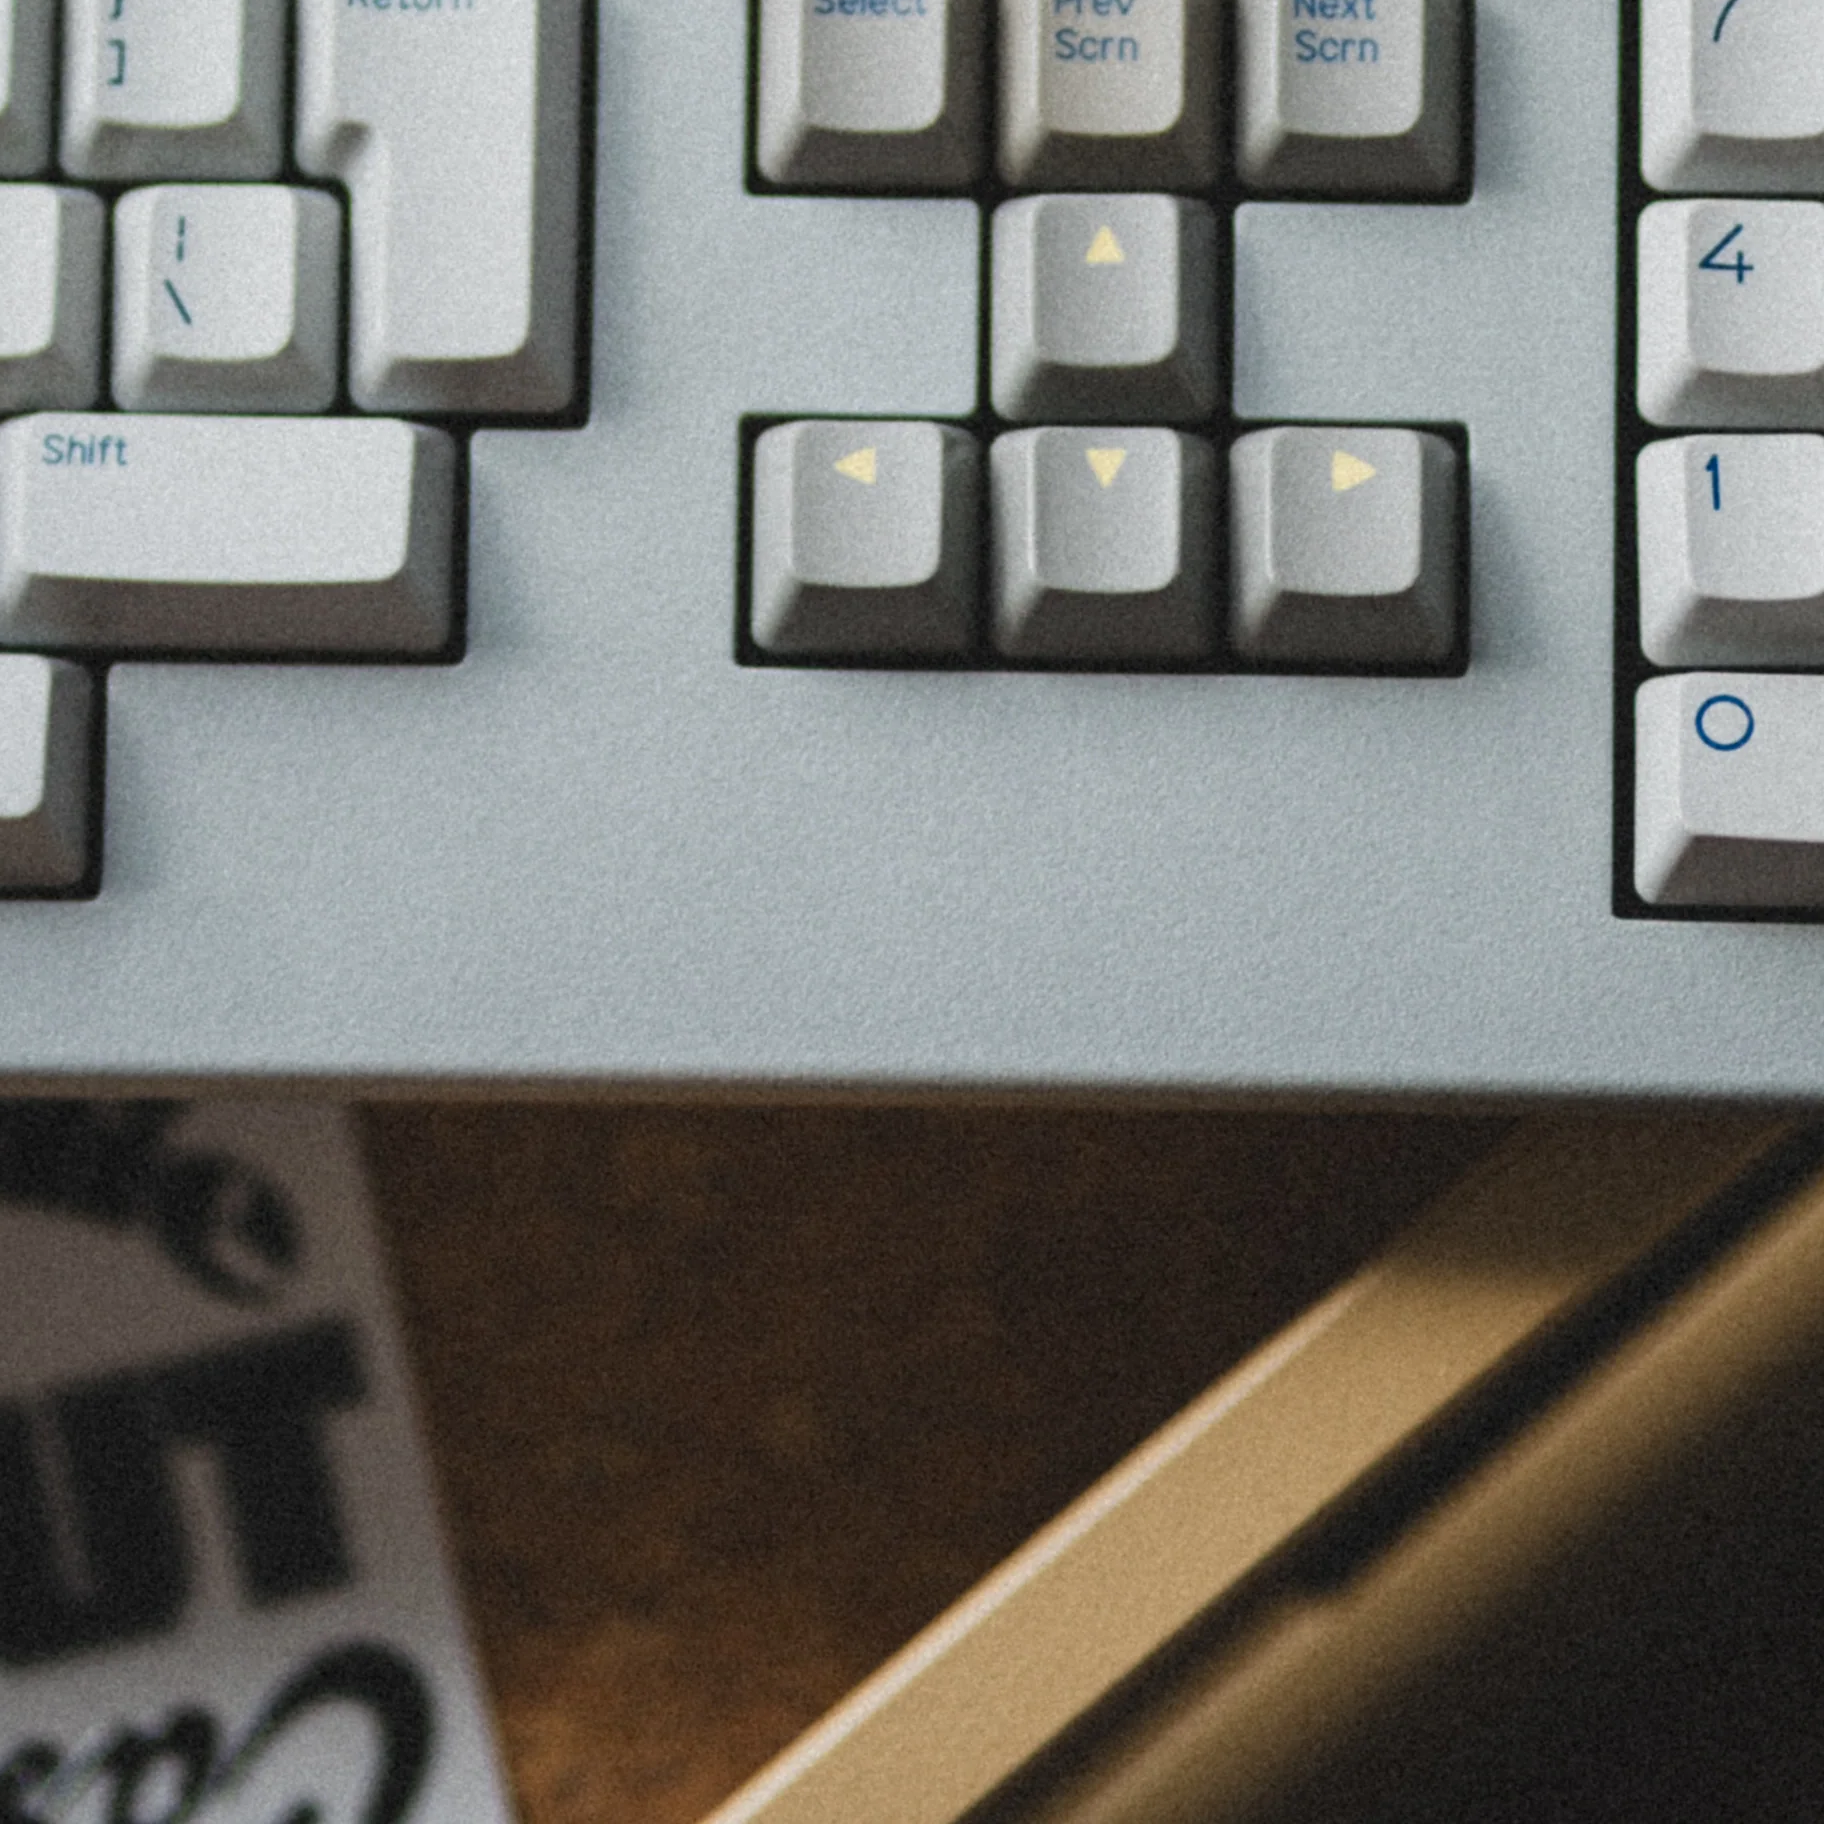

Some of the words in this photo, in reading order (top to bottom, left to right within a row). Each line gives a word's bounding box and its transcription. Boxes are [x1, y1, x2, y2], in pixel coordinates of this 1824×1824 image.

[107, 37, 128, 88] ]
[1052, 24, 1138, 64] Scrn
[1291, 26, 1378, 66] Scrn
[1696, 223, 1754, 285] 4
[162, 278, 193, 326] \
[42, 433, 128, 467] Shift
[1704, 453, 1722, 512] 1
